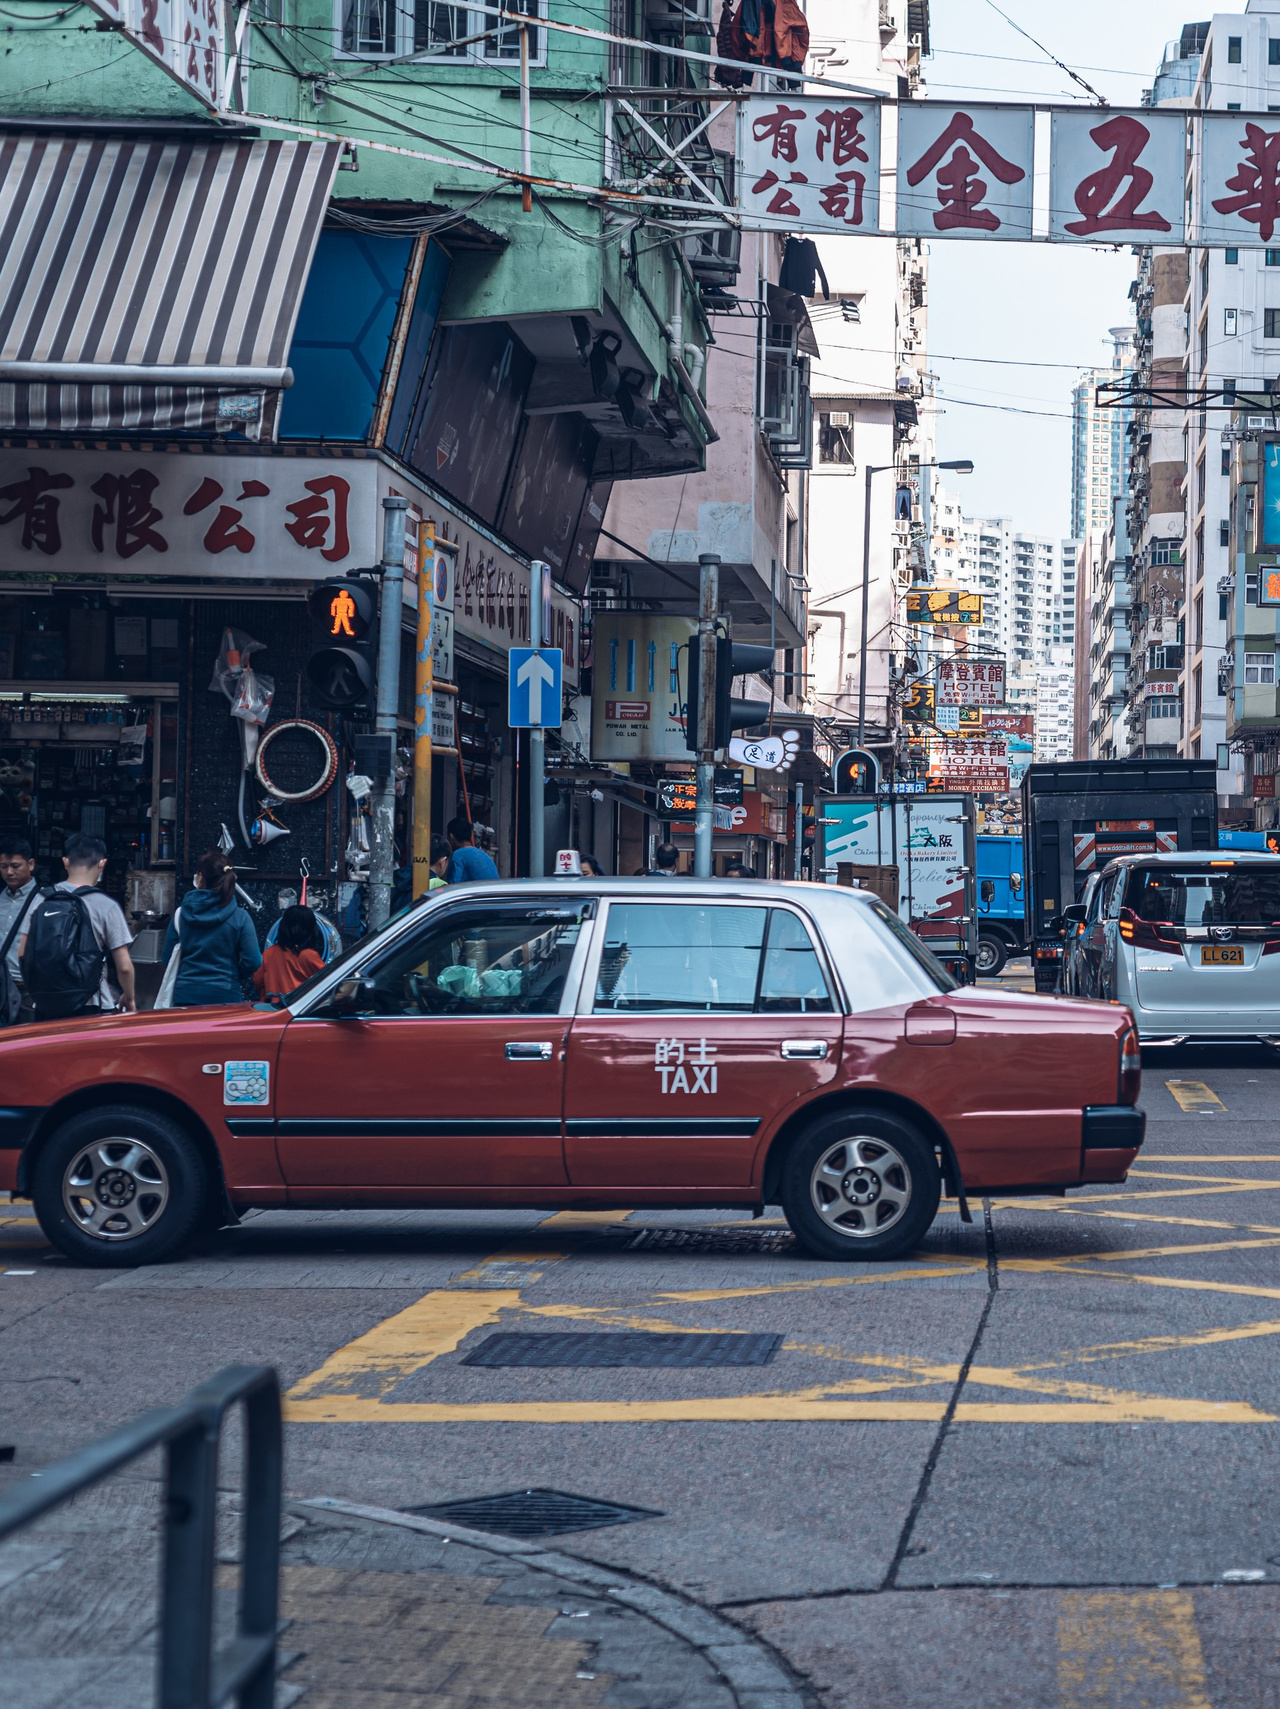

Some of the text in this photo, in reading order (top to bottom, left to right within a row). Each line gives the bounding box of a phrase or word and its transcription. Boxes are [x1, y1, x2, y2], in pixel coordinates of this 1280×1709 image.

[0, 466, 350, 562] 有限公司
[944, 683, 999, 692] HOTEL
[939, 757, 999, 765] HOTEL
[924, 835, 952, 848] 大阪
[1203, 950, 1242, 961] LL 621
[655, 1038, 717, 1065] 的士
[654, 1066, 717, 1094] TAXI
